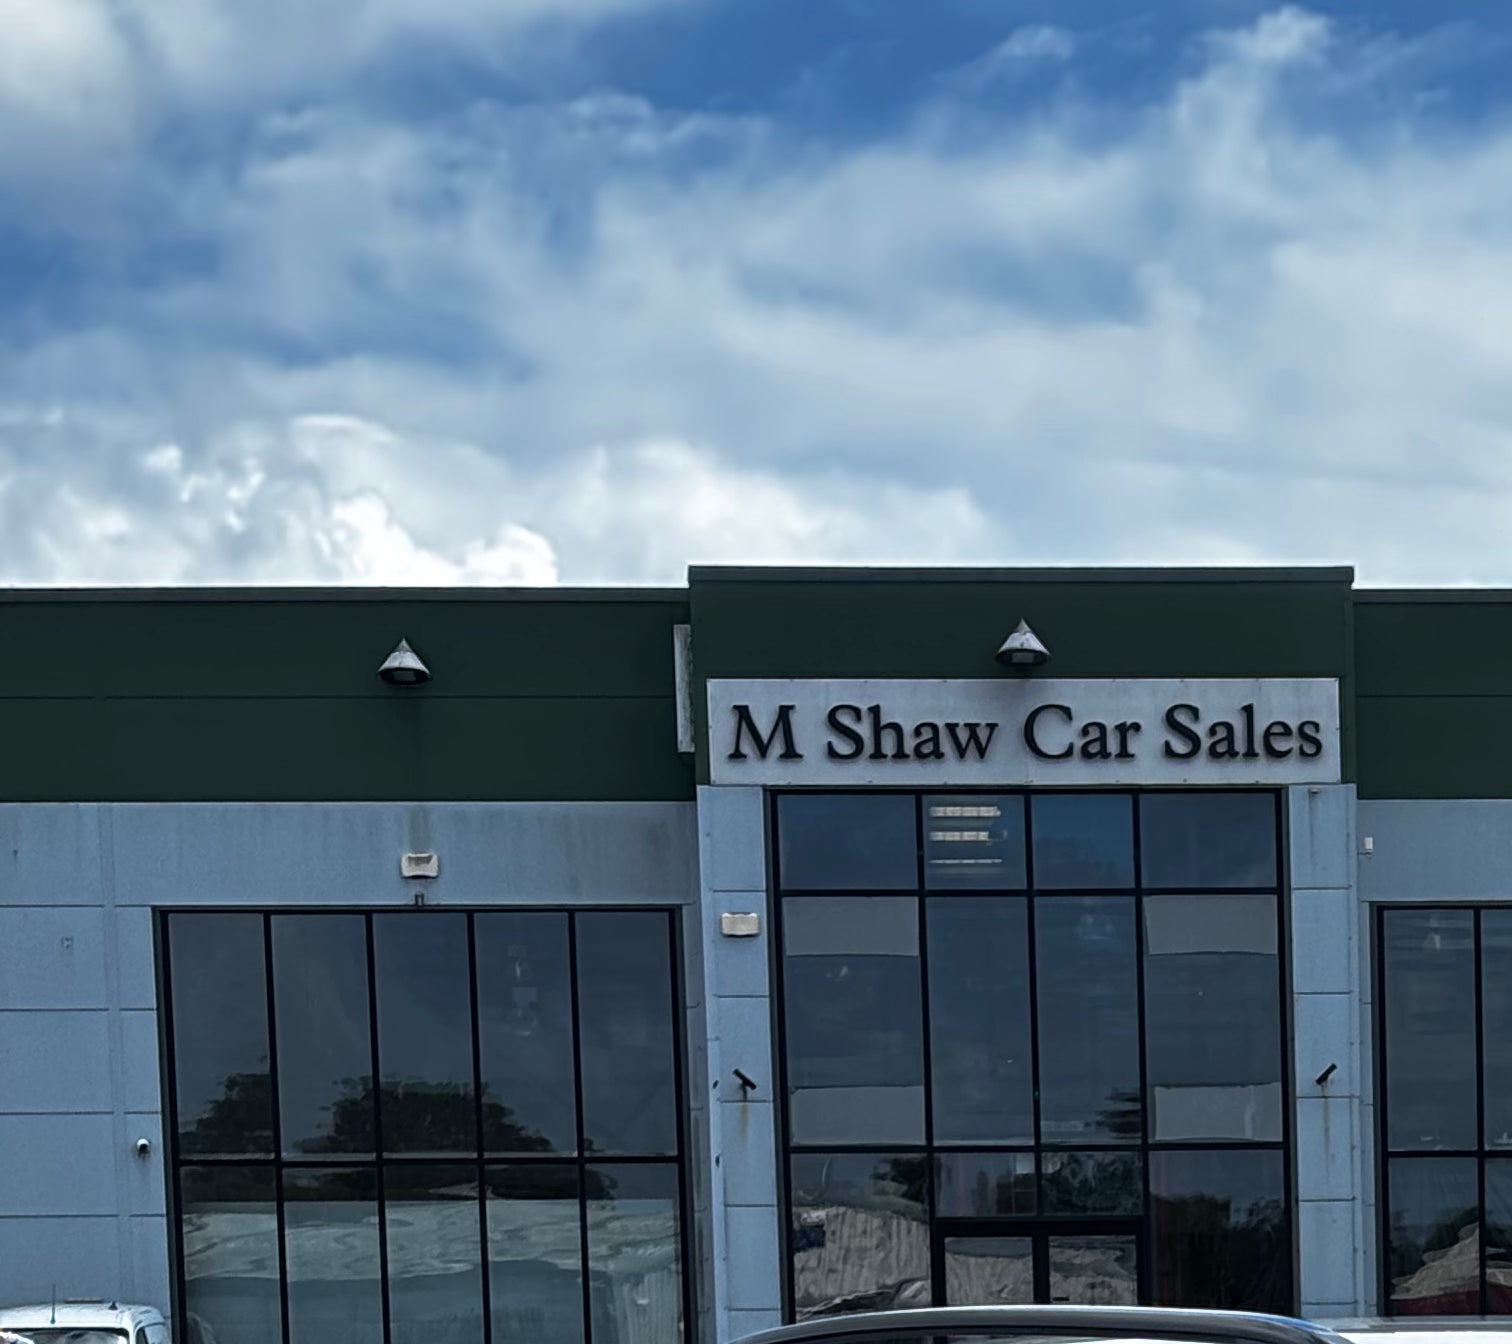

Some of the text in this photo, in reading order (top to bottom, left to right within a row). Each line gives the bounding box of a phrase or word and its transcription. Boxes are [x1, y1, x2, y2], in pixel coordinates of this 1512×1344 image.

[727, 702, 1323, 761] M Shaw Car Sales
